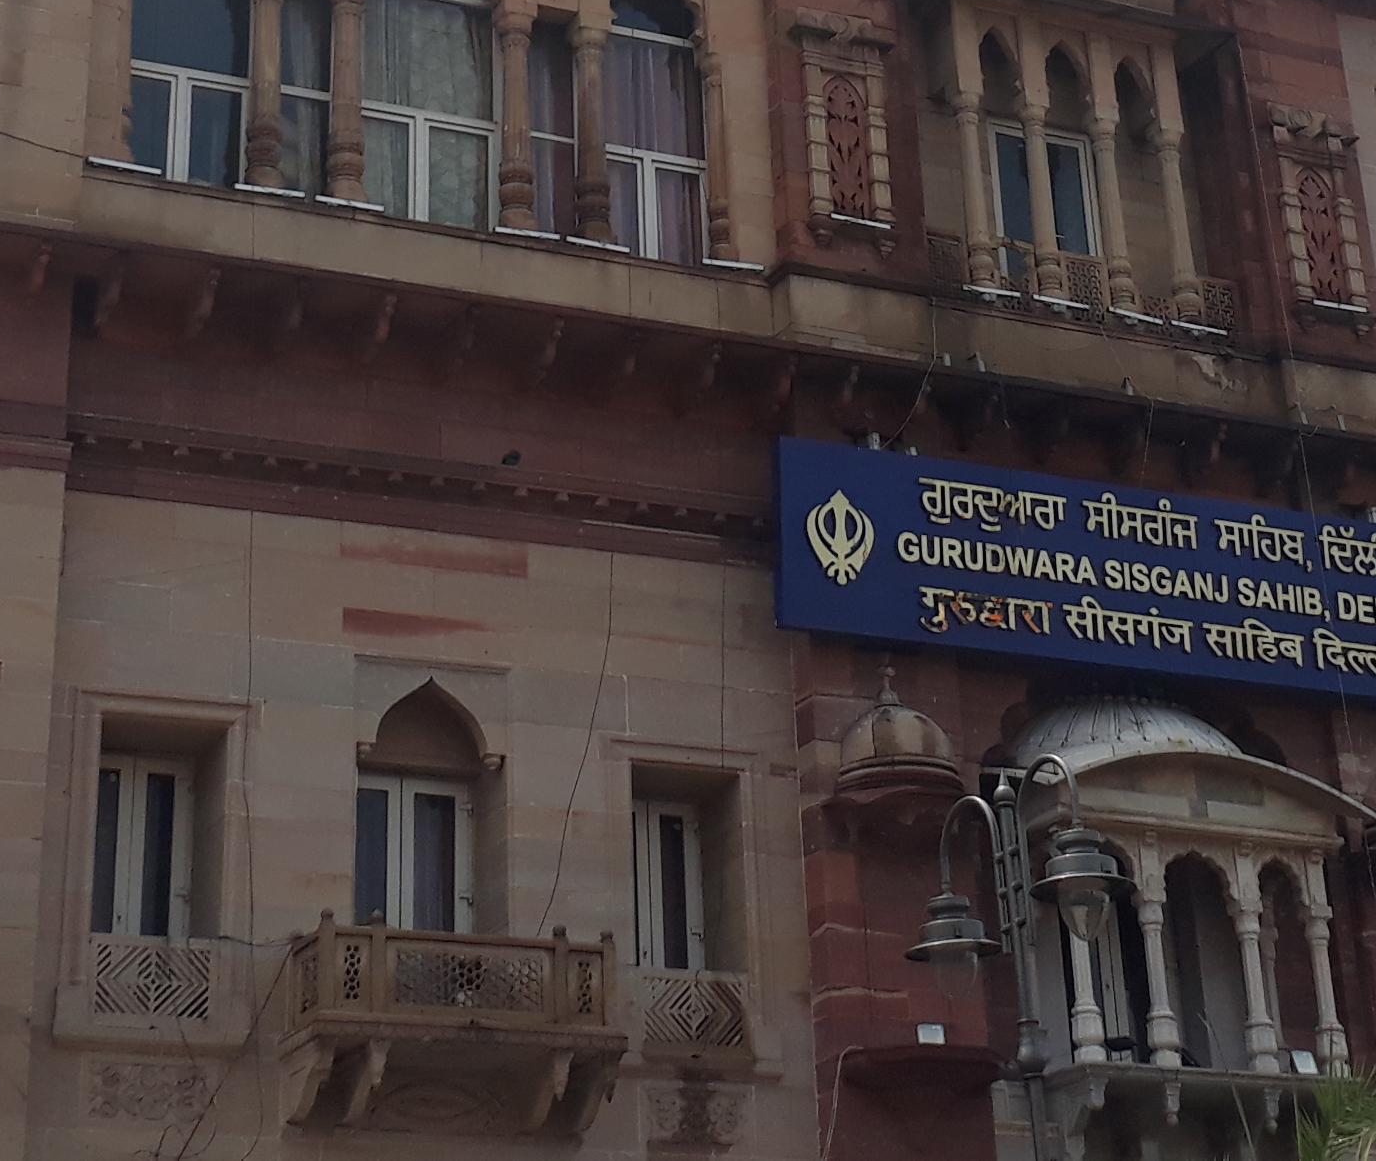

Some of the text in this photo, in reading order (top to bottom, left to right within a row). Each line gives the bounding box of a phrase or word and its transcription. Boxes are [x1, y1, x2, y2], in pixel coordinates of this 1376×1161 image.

[919, 477, 1067, 532] ਗੁਰਦੁਆਰਾ
[1082, 492, 1198, 550] ਸੀਸਗੰਜ
[1214, 515, 1313, 572] ਸਾਹਿਬ,
[897, 531, 1099, 586] GURUDWARA
[1104, 559, 1229, 604] SISGANJ
[1237, 577, 1331, 622] SAHIB,
[1062, 595, 1194, 653] सीसगंज
[1202, 621, 1305, 667] साहिब
